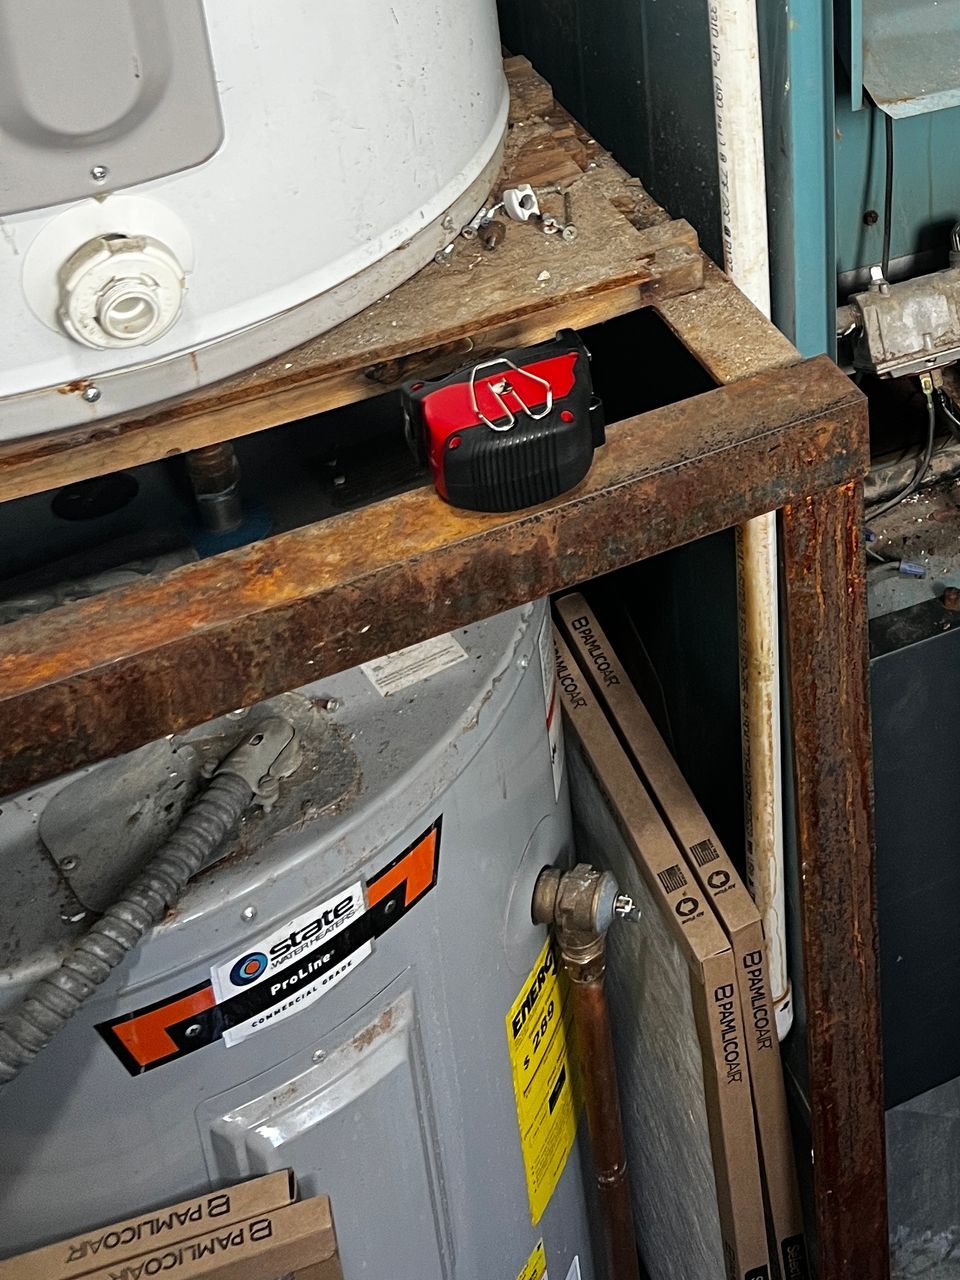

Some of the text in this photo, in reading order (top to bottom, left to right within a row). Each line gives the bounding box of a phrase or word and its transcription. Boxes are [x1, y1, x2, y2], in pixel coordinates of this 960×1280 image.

[269, 895, 355, 962] state
[271, 908, 357, 969] WATER HEATERS
[251, 960, 353, 1028] COMMERCIAL GRADE
[270, 953, 332, 997] ProLine
[533, 999, 554, 1055] 289
[747, 967, 773, 1052] PAMLICOAIR
[716, 1000, 743, 1086] PAMLICOAIR
[65, 1202, 203, 1264] PAMLICOAIR
